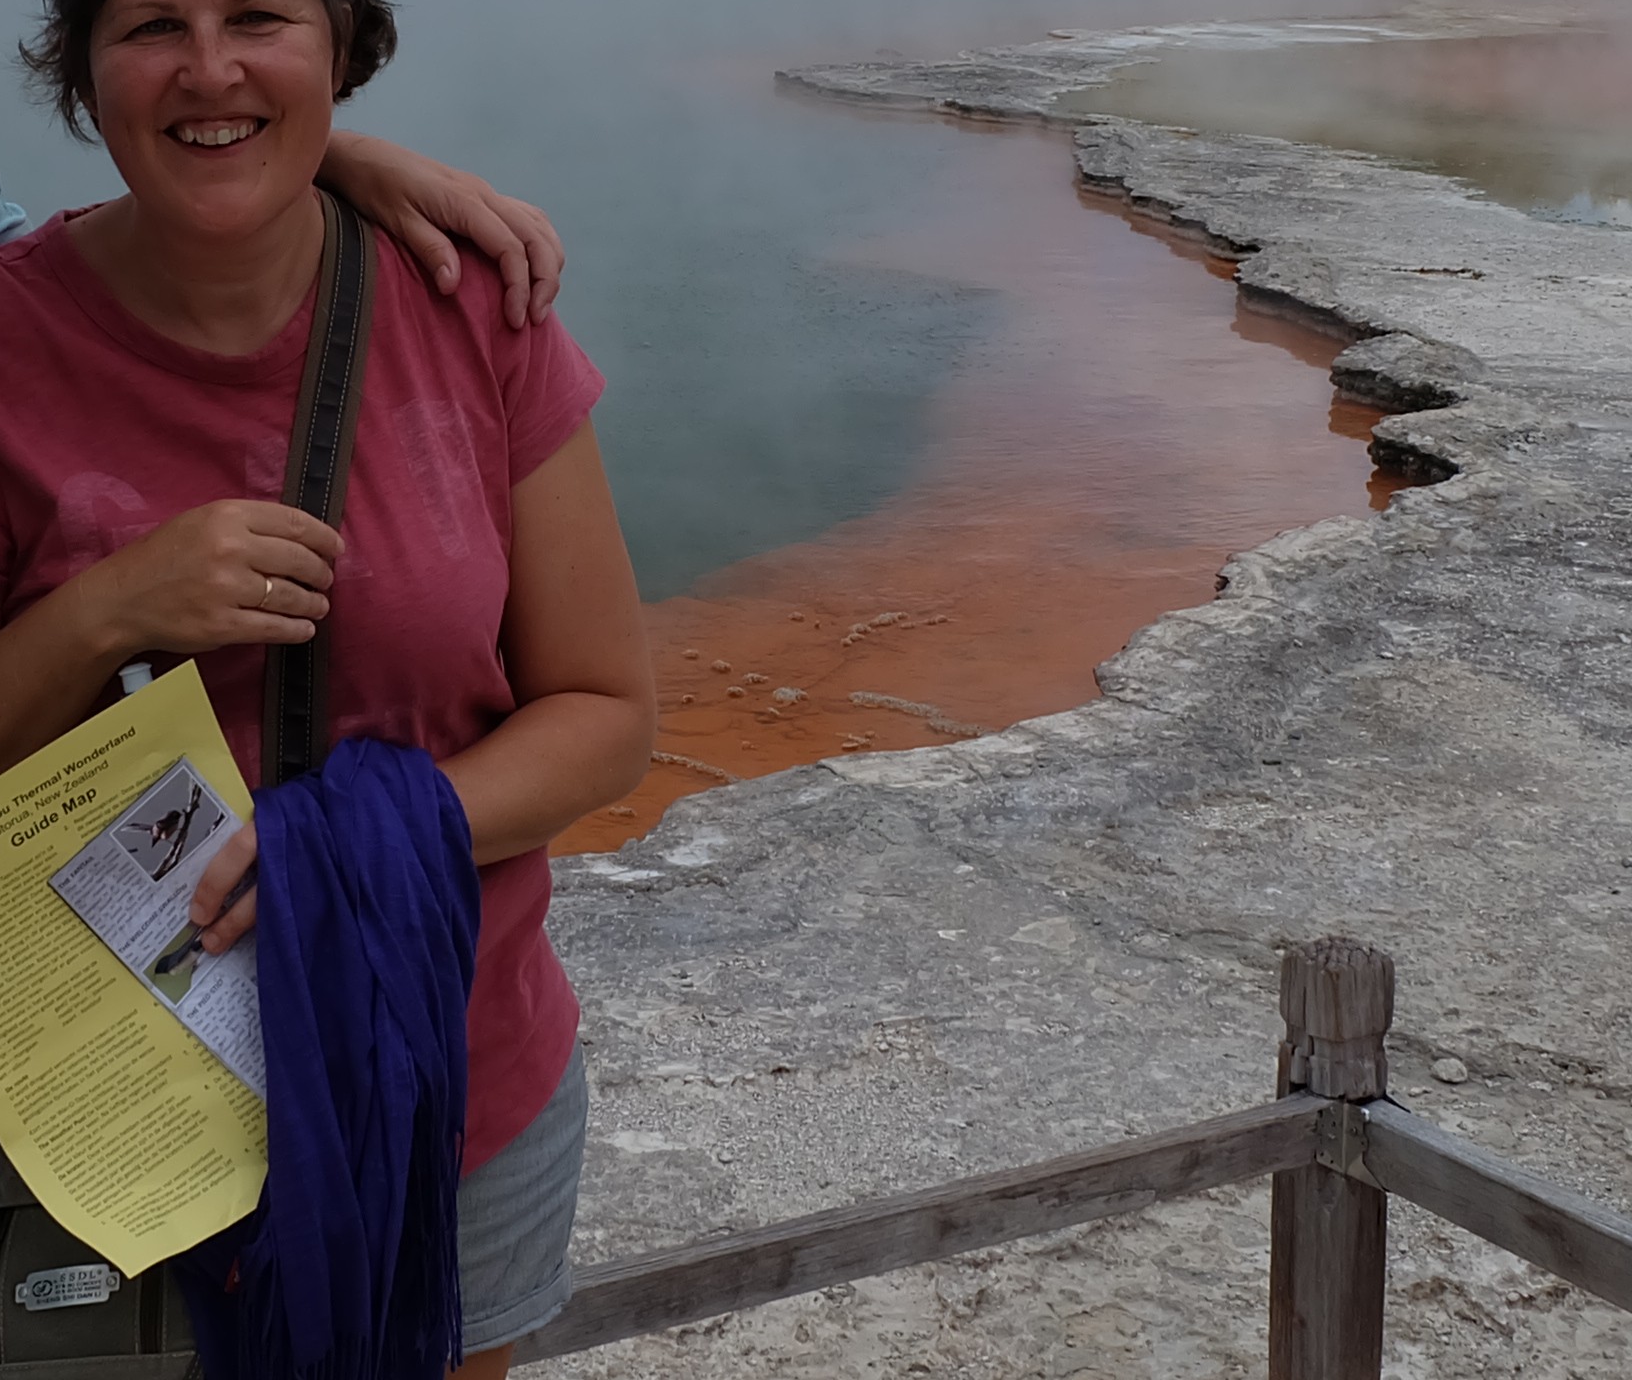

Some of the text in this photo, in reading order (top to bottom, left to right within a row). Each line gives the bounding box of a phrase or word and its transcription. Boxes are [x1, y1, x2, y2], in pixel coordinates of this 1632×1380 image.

[11, 770, 62, 807] Thermal
[62, 725, 136, 776] Wonderland
[33, 789, 61, 811] New
[62, 758, 109, 794] Zealand
[10, 787, 97, 847] Guide Map
